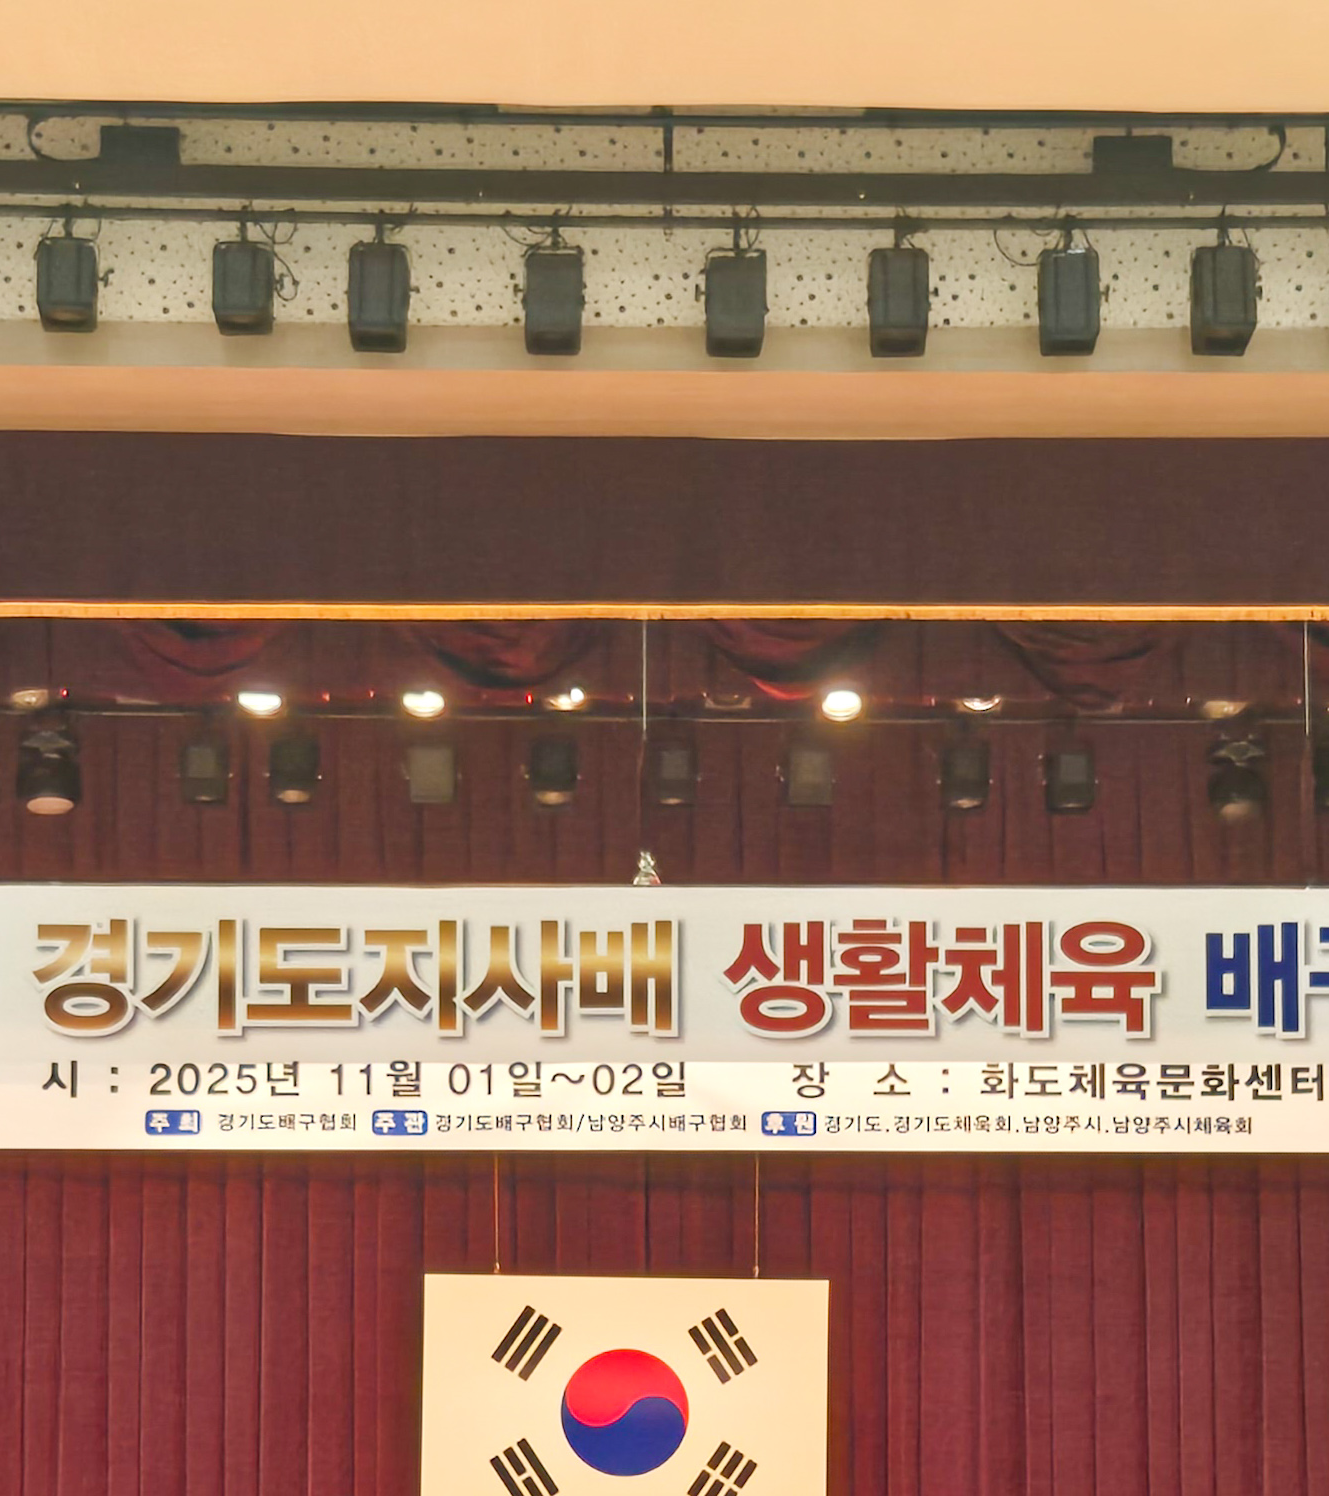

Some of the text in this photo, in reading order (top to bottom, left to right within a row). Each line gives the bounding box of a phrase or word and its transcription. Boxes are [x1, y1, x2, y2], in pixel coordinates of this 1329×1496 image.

[32, 917, 673, 1035] 경기도지사배
[723, 917, 1157, 1034] 생활체육
[41, 1060, 79, 1098] 시
[149, 1060, 301, 1097] 2025년
[330, 1060, 422, 1097] 11월
[792, 1061, 830, 1099] 장
[873, 1063, 912, 1097] 소
[980, 1062, 1325, 1102] 화도체육문화센터
[218, 1113, 357, 1132] 경기도배구협회
